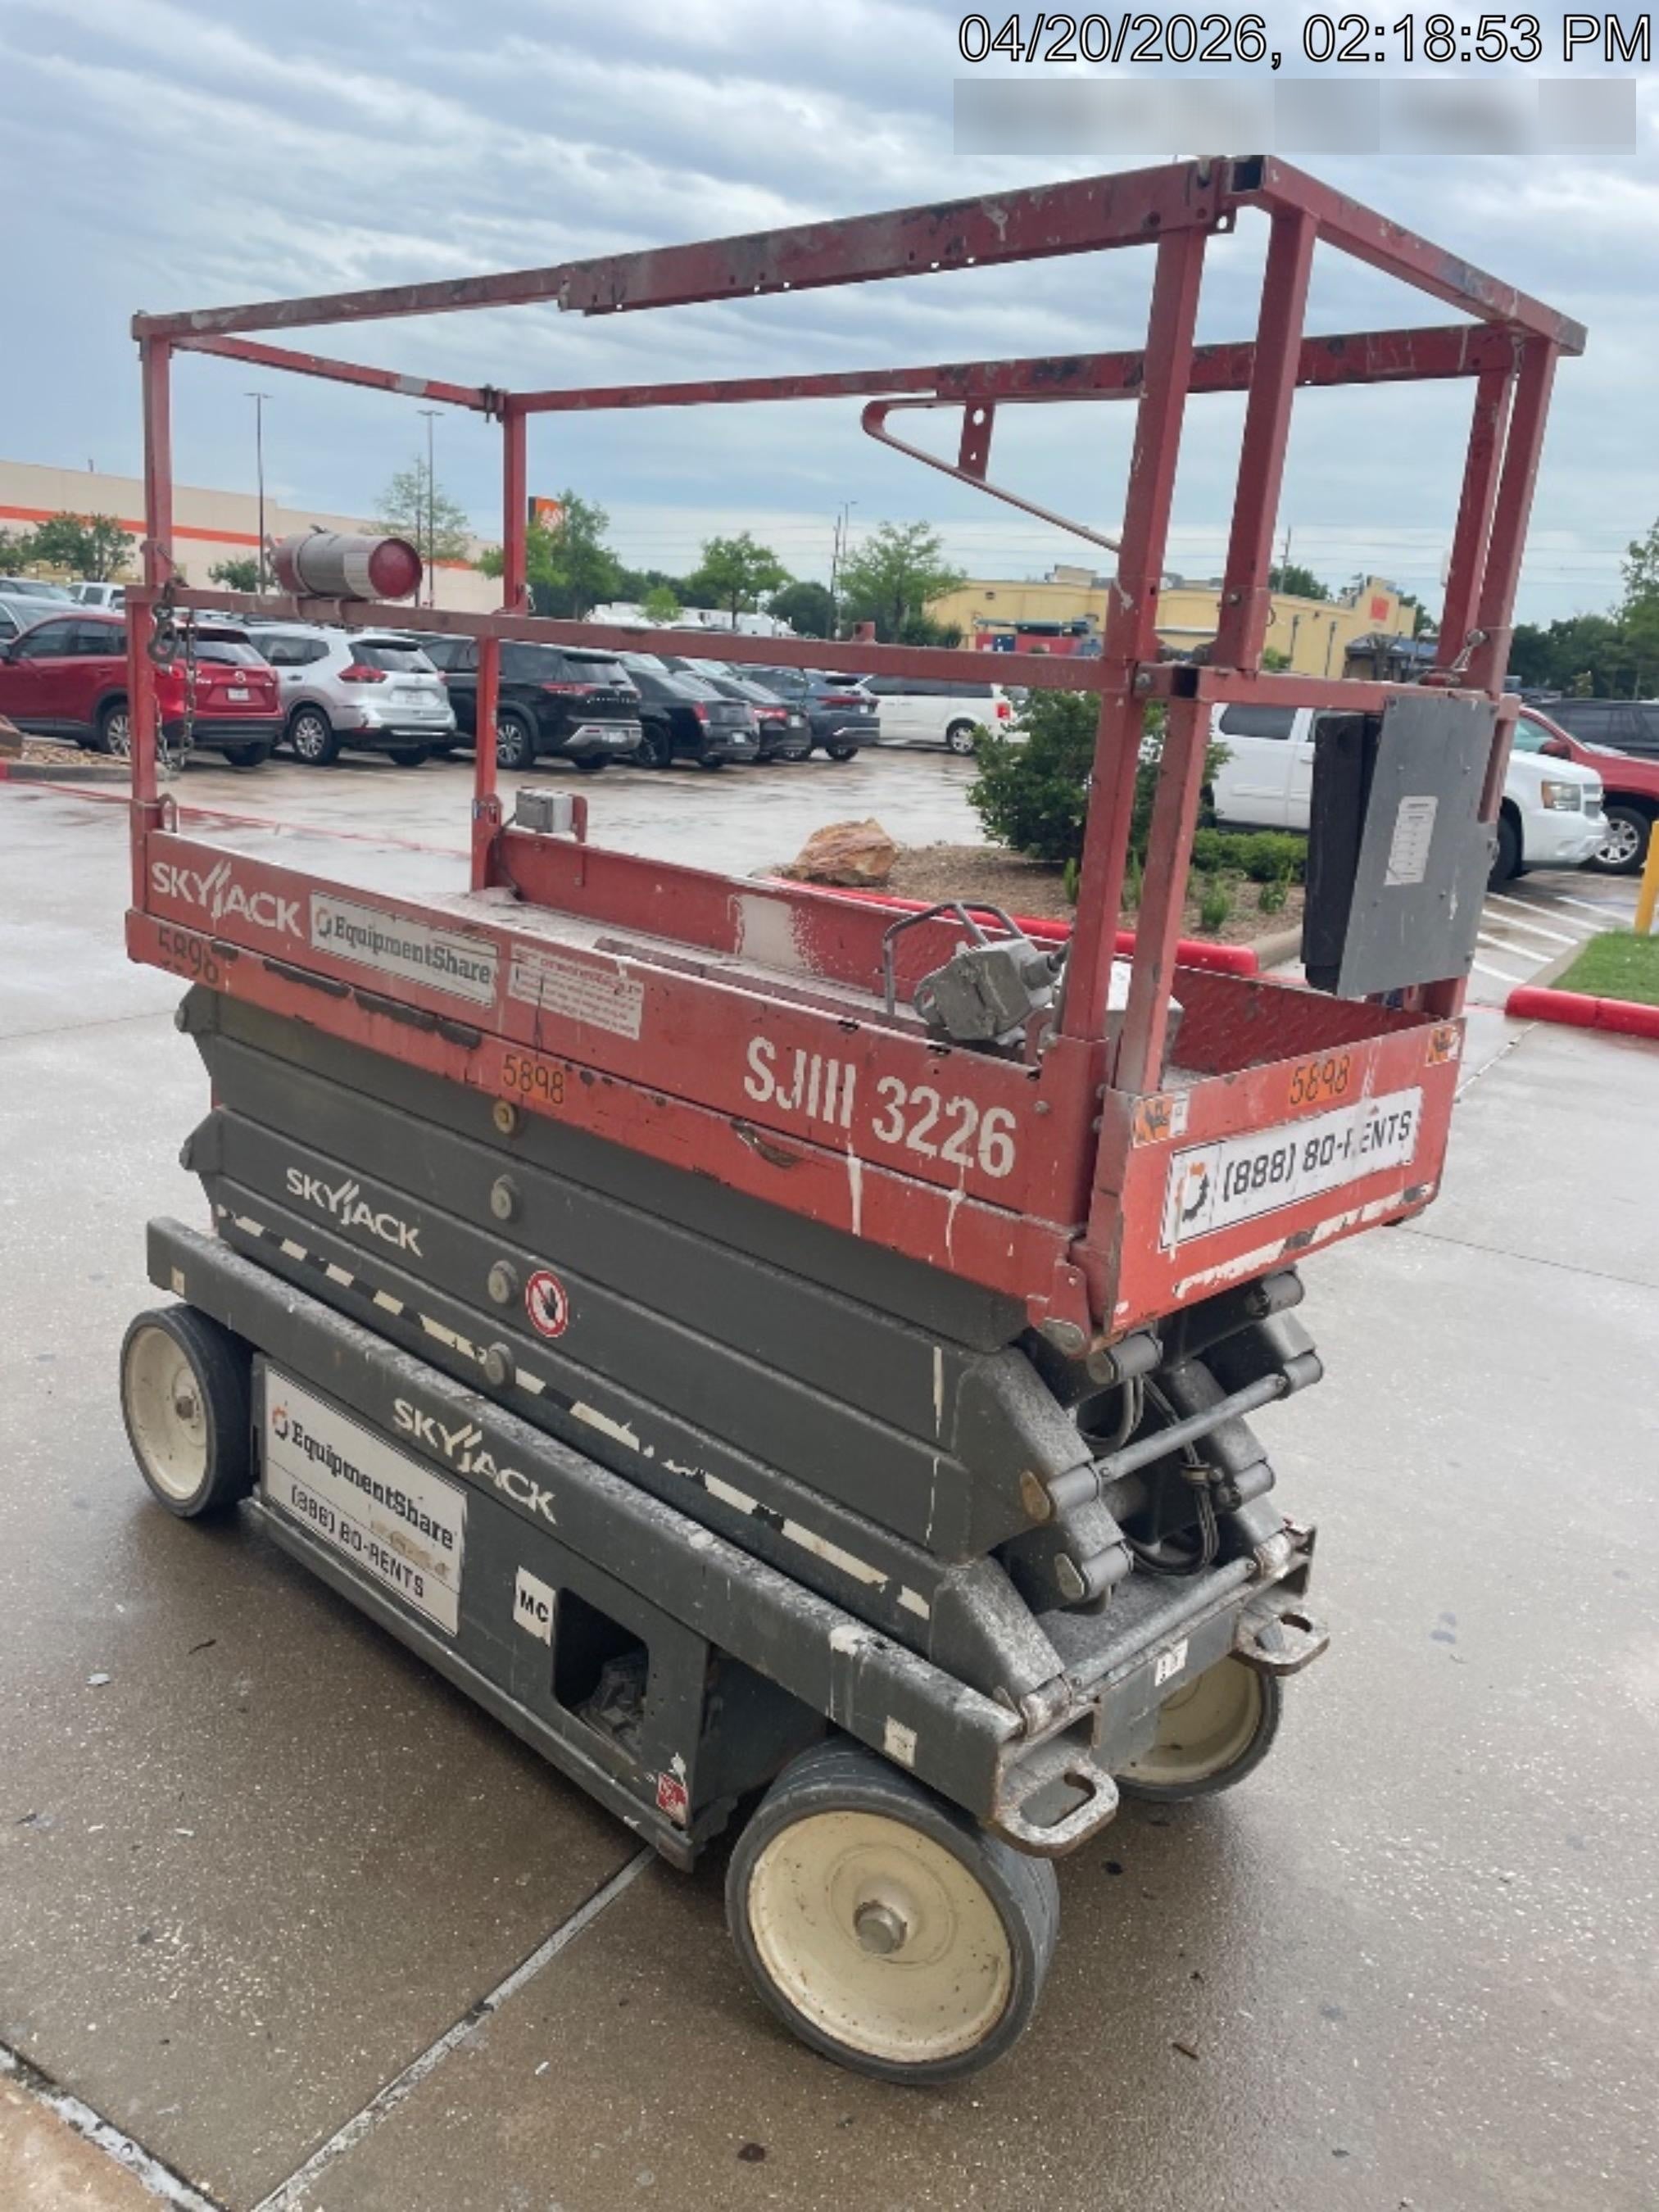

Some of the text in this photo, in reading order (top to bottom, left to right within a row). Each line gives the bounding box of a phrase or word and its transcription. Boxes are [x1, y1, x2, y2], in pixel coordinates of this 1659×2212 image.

[151, 859, 305, 940] SKYJACK
[335, 913, 491, 984] EquipmentShare
[503, 1054, 564, 1105] 5898
[1290, 1054, 1350, 1104] 5898
[872, 1076, 1016, 1178] 3226
[1223, 1142, 1296, 1203] (888)
[287, 1167, 424, 1258] SKYJACK
[291, 1419, 454, 1552] EquipmentShare
[393, 1397, 557, 1525] SKYJACK
[519, 1589, 549, 1623] MC
